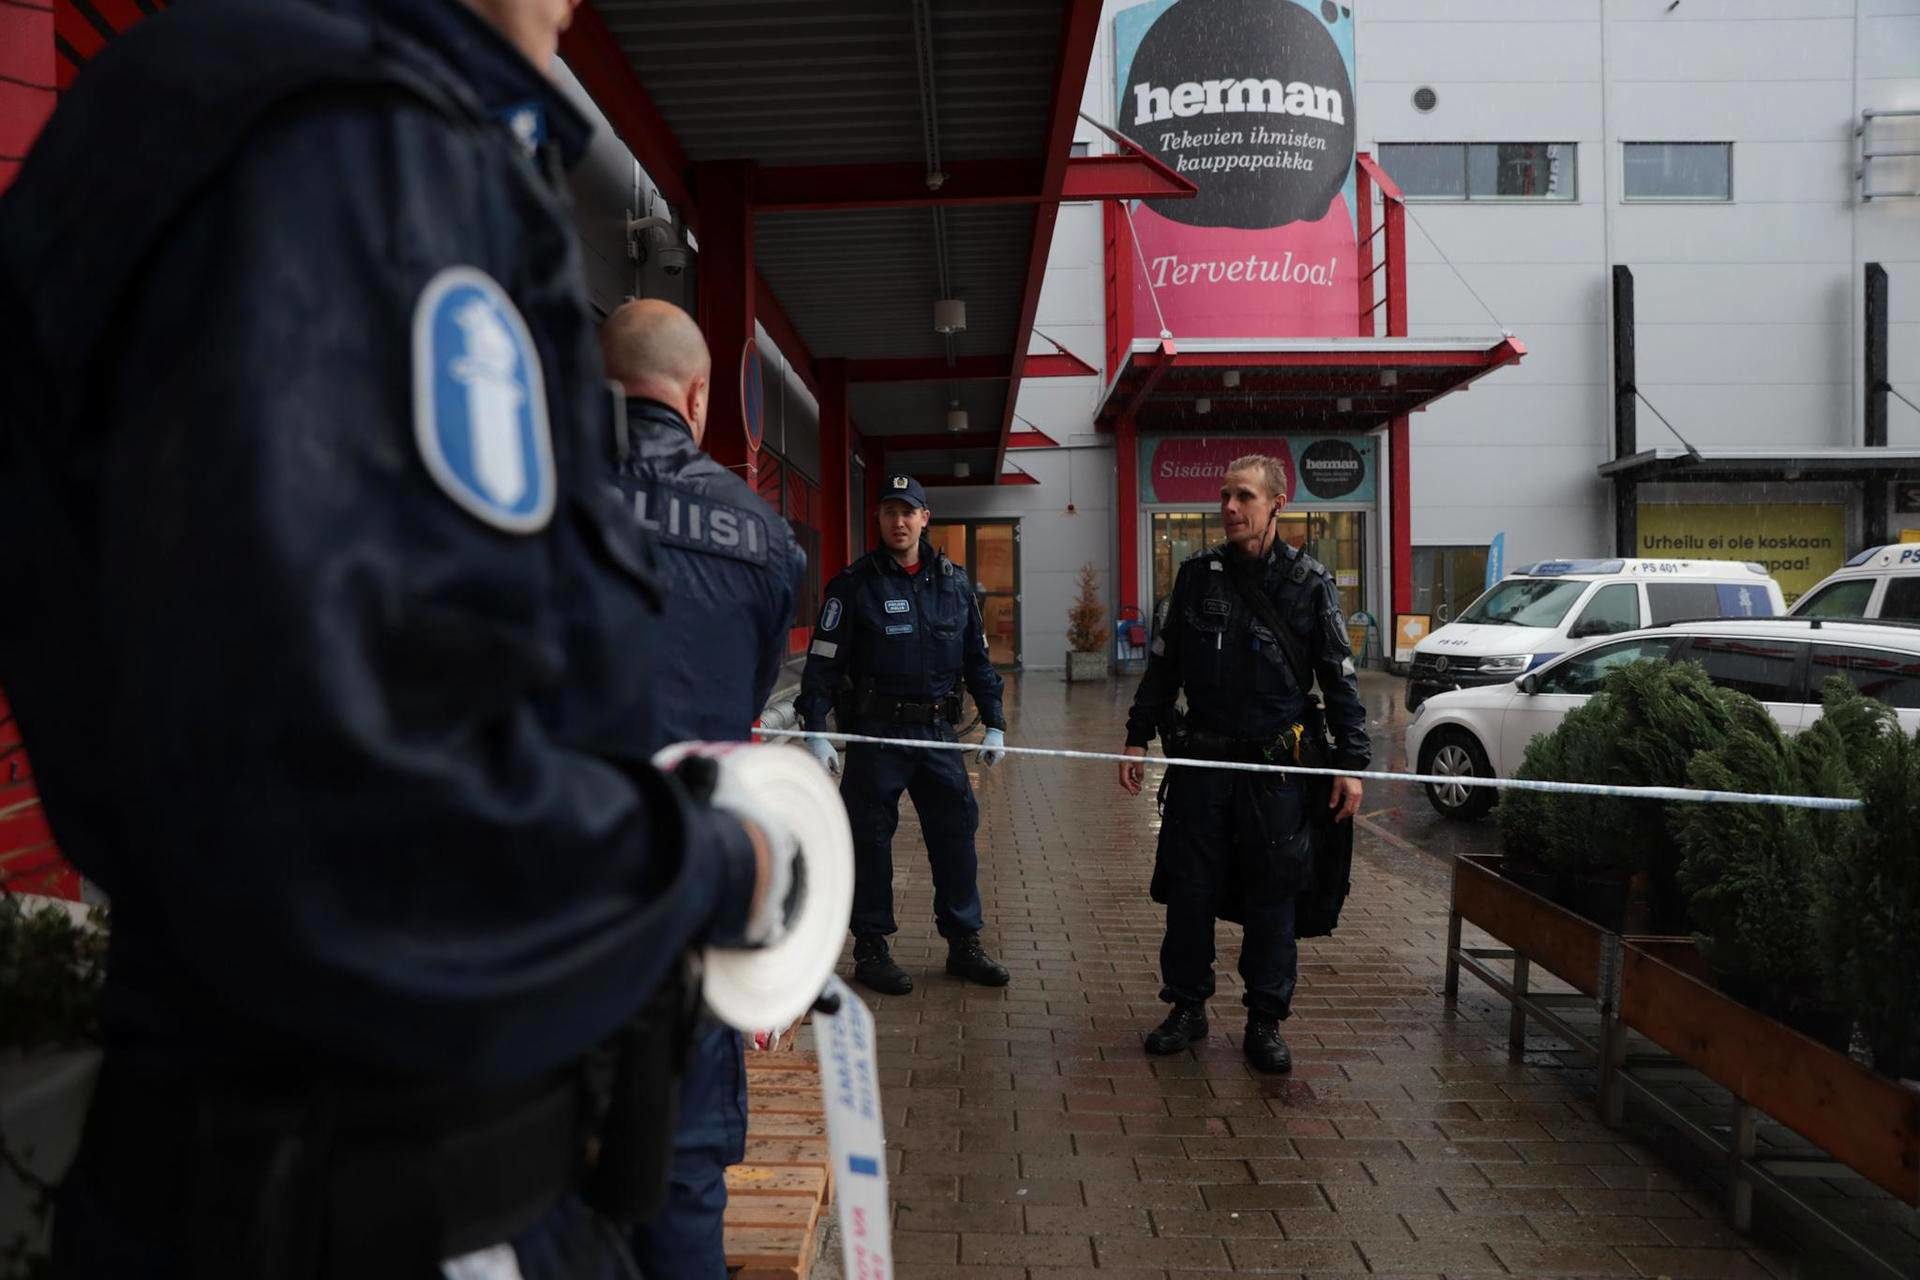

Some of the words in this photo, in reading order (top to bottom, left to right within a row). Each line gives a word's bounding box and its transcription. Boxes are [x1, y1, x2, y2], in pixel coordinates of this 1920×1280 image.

[1133, 77, 1345, 126] herman
[1159, 130, 1243, 152] Tekevien
[1250, 126, 1327, 151] ihmisten
[1176, 151, 1314, 173] kauppapaikka
[1151, 251, 1338, 288] Tervetuloa!
[1643, 535, 1704, 550] Urheilu
[1708, 535, 1723, 550] ei
[1728, 535, 1754, 550] ole
[1758, 534, 1832, 550] koskaan
[1641, 563, 1657, 573] PS
[1659, 563, 1678, 574] 401
